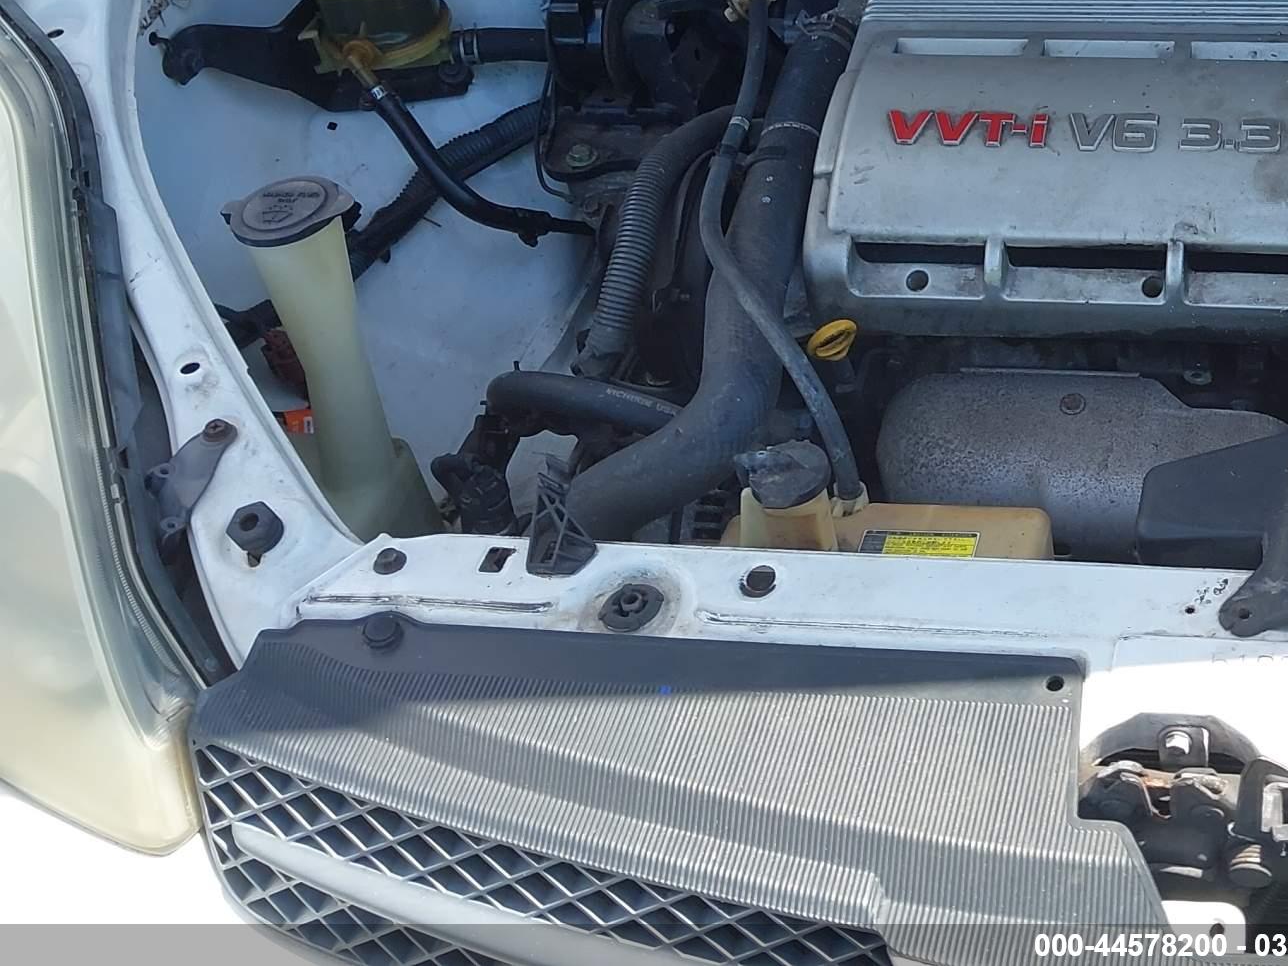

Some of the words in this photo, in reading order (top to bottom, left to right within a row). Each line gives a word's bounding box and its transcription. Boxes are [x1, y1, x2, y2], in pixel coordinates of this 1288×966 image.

[888, 110, 1050, 146] VVT-i
[1067, 112, 1161, 153] V6
[1178, 117, 1283, 154] 3.3
